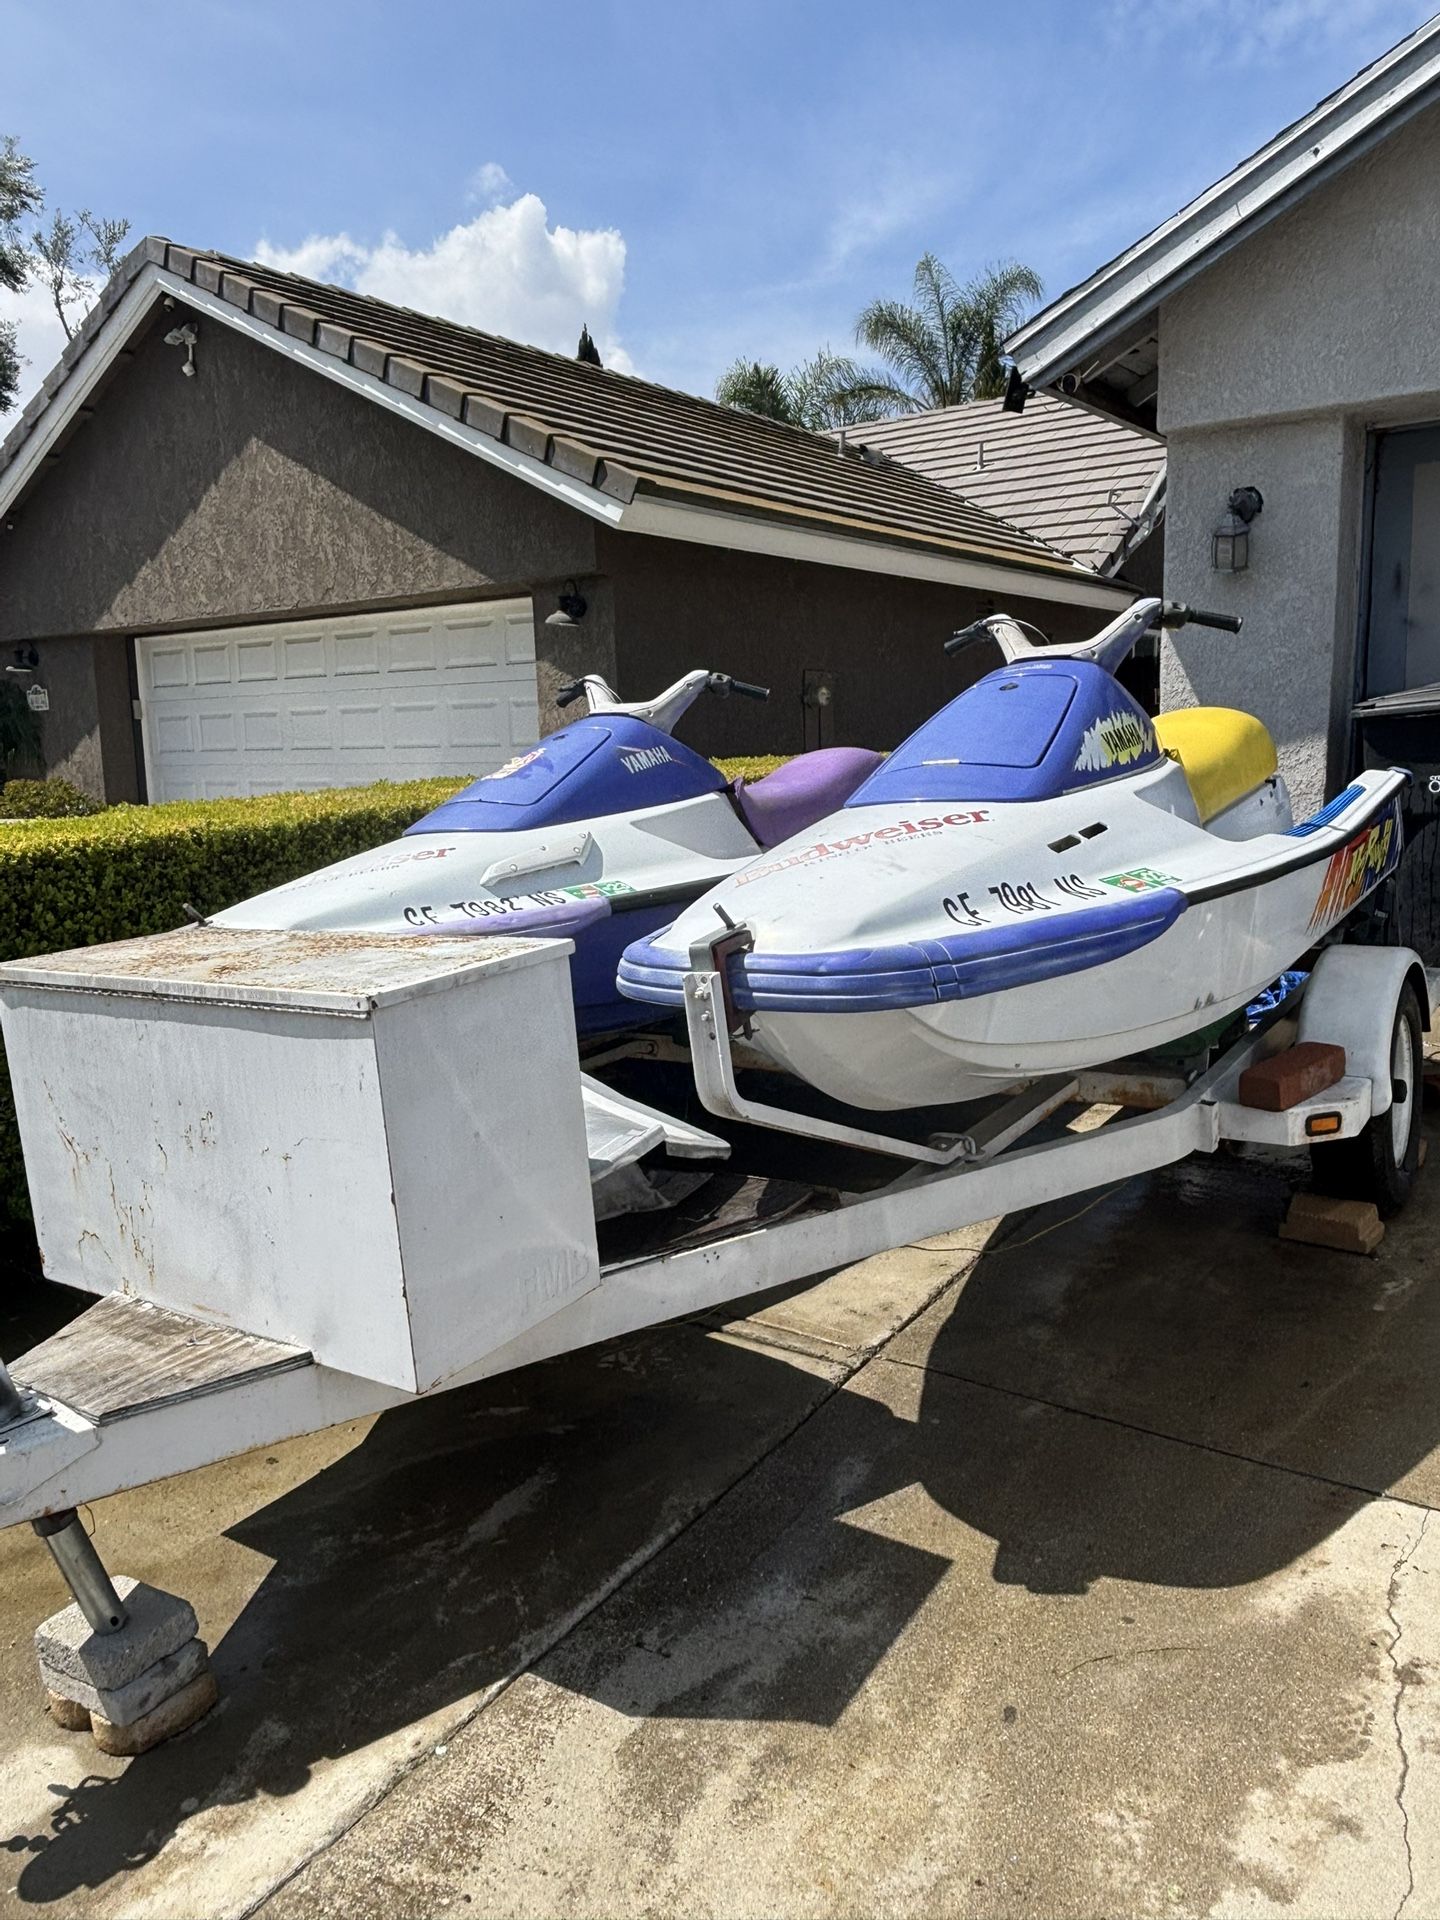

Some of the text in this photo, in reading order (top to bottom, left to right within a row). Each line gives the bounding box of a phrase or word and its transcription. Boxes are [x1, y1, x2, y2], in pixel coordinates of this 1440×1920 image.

[1101, 722, 1142, 754] YAMAHA
[620, 746, 673, 774] YAMAHA
[734, 809, 990, 887] Budweiser
[403, 890, 567, 926] CF 7982 NS
[943, 892, 991, 927] CF
[988, 880, 1061, 915] 7981
[1053, 873, 1107, 901] NS
